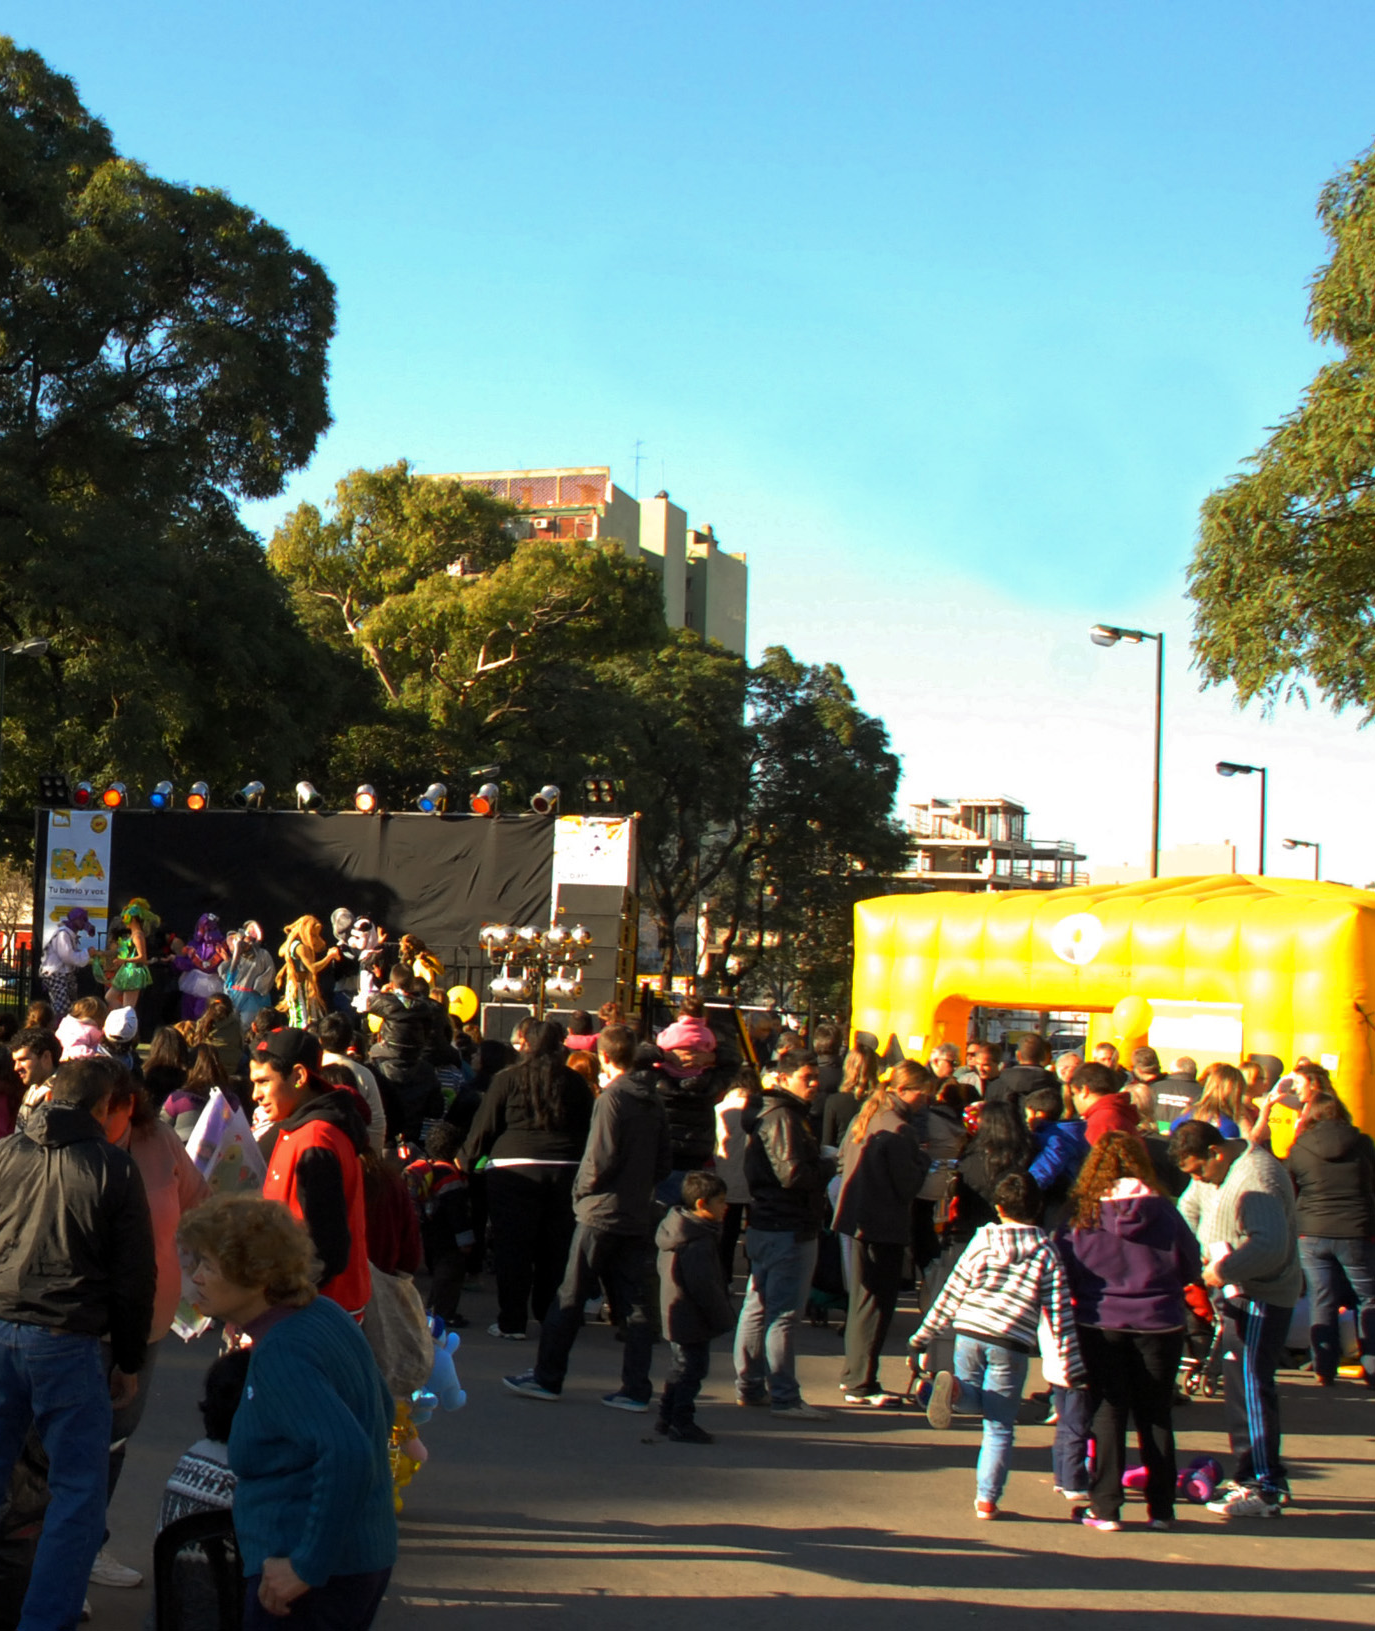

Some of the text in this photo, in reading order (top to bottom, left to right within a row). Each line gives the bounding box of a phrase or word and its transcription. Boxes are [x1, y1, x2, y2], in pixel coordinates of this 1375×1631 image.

[49, 886, 58, 895] Tu
[59, 886, 83, 896] barrio
[85, 888, 90, 897] y
